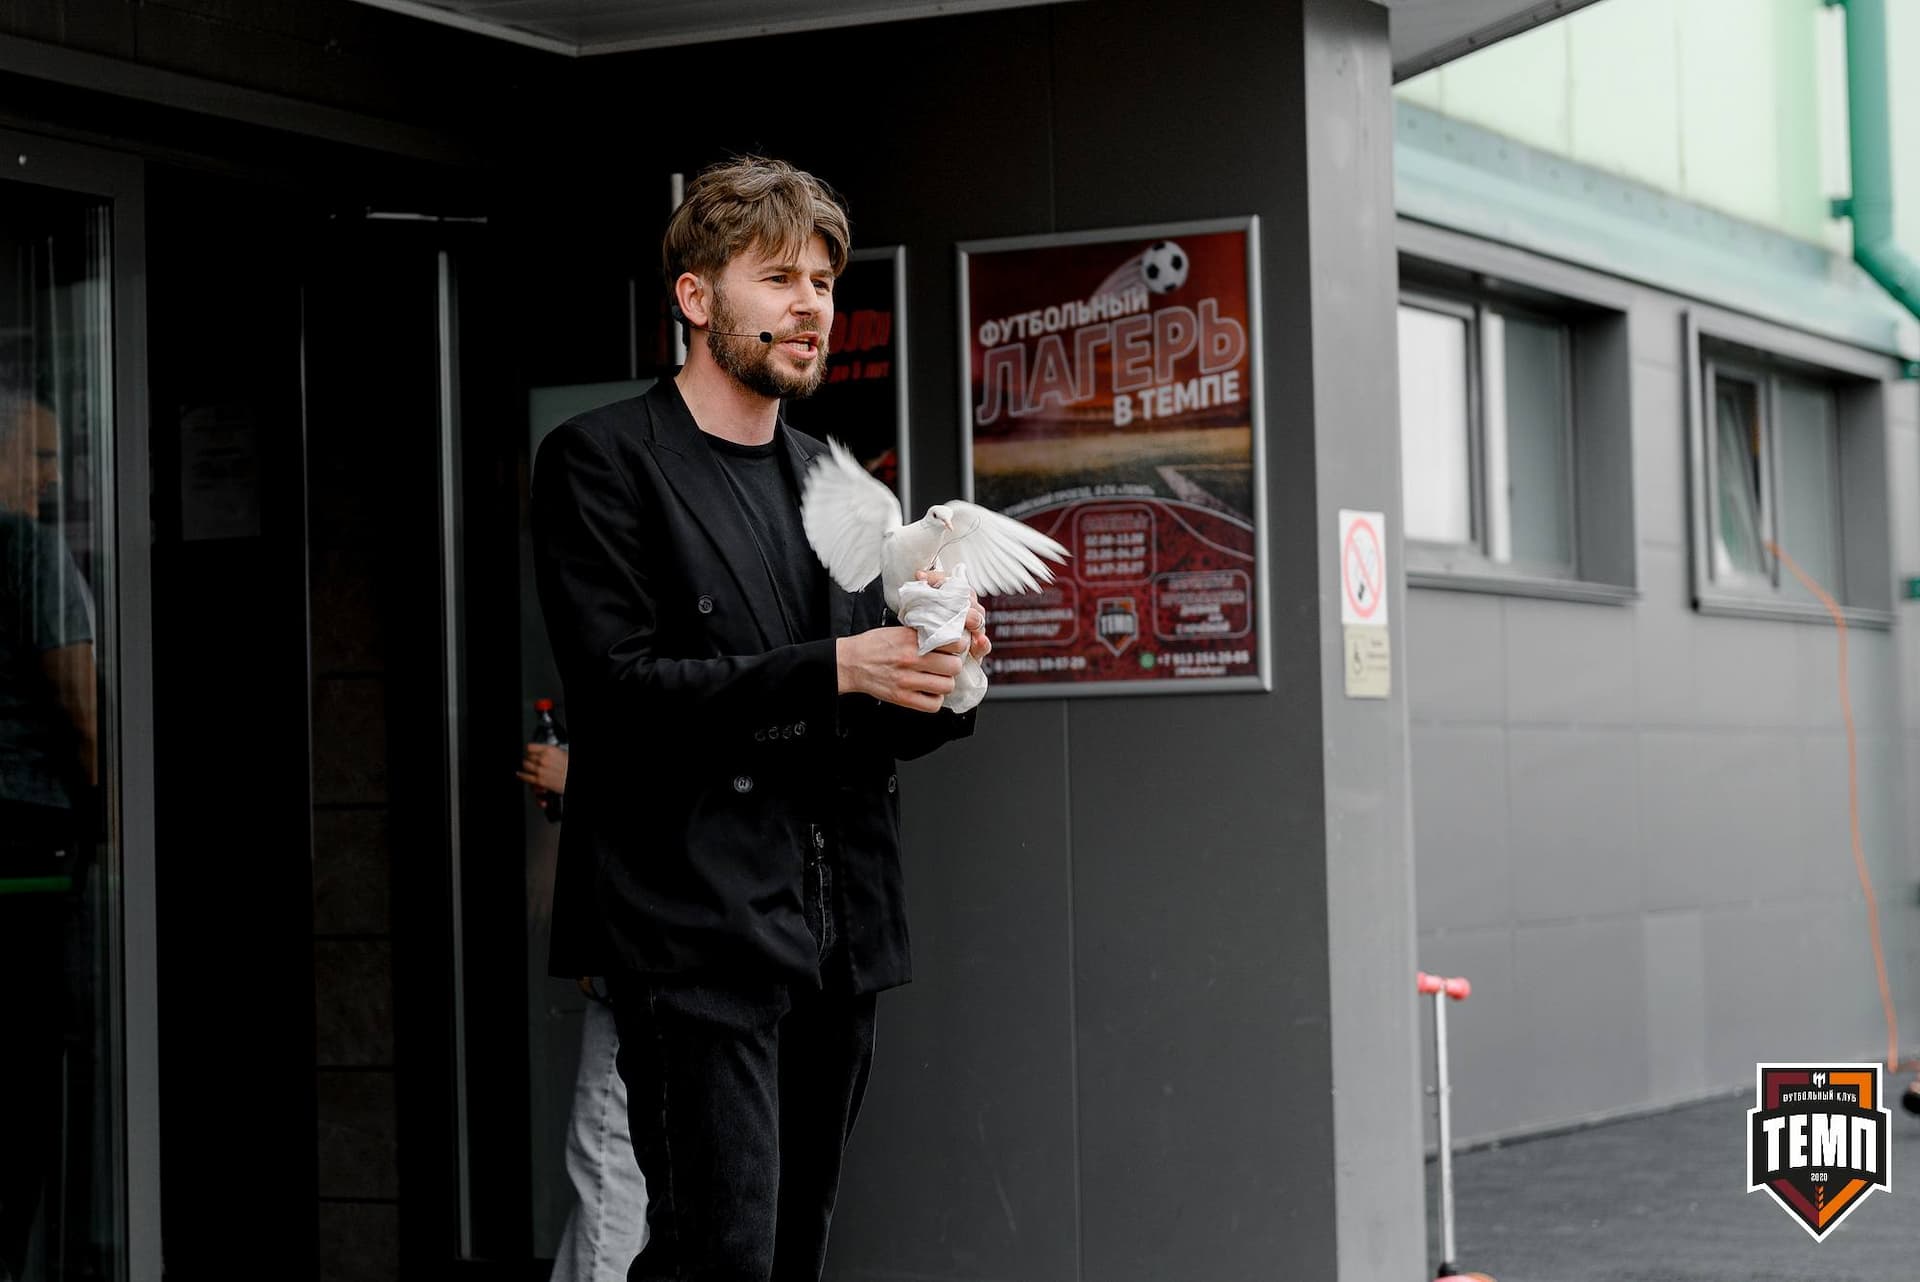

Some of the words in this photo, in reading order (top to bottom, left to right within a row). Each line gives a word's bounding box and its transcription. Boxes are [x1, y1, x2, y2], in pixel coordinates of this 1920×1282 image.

[979, 286, 1149, 347] ФУТБОЛЬНЫЙ
[976, 298, 1246, 426] ЛАГЕРЬ
[1113, 394, 1133, 427] В
[1139, 372, 1240, 420] ТЕМПЕ
